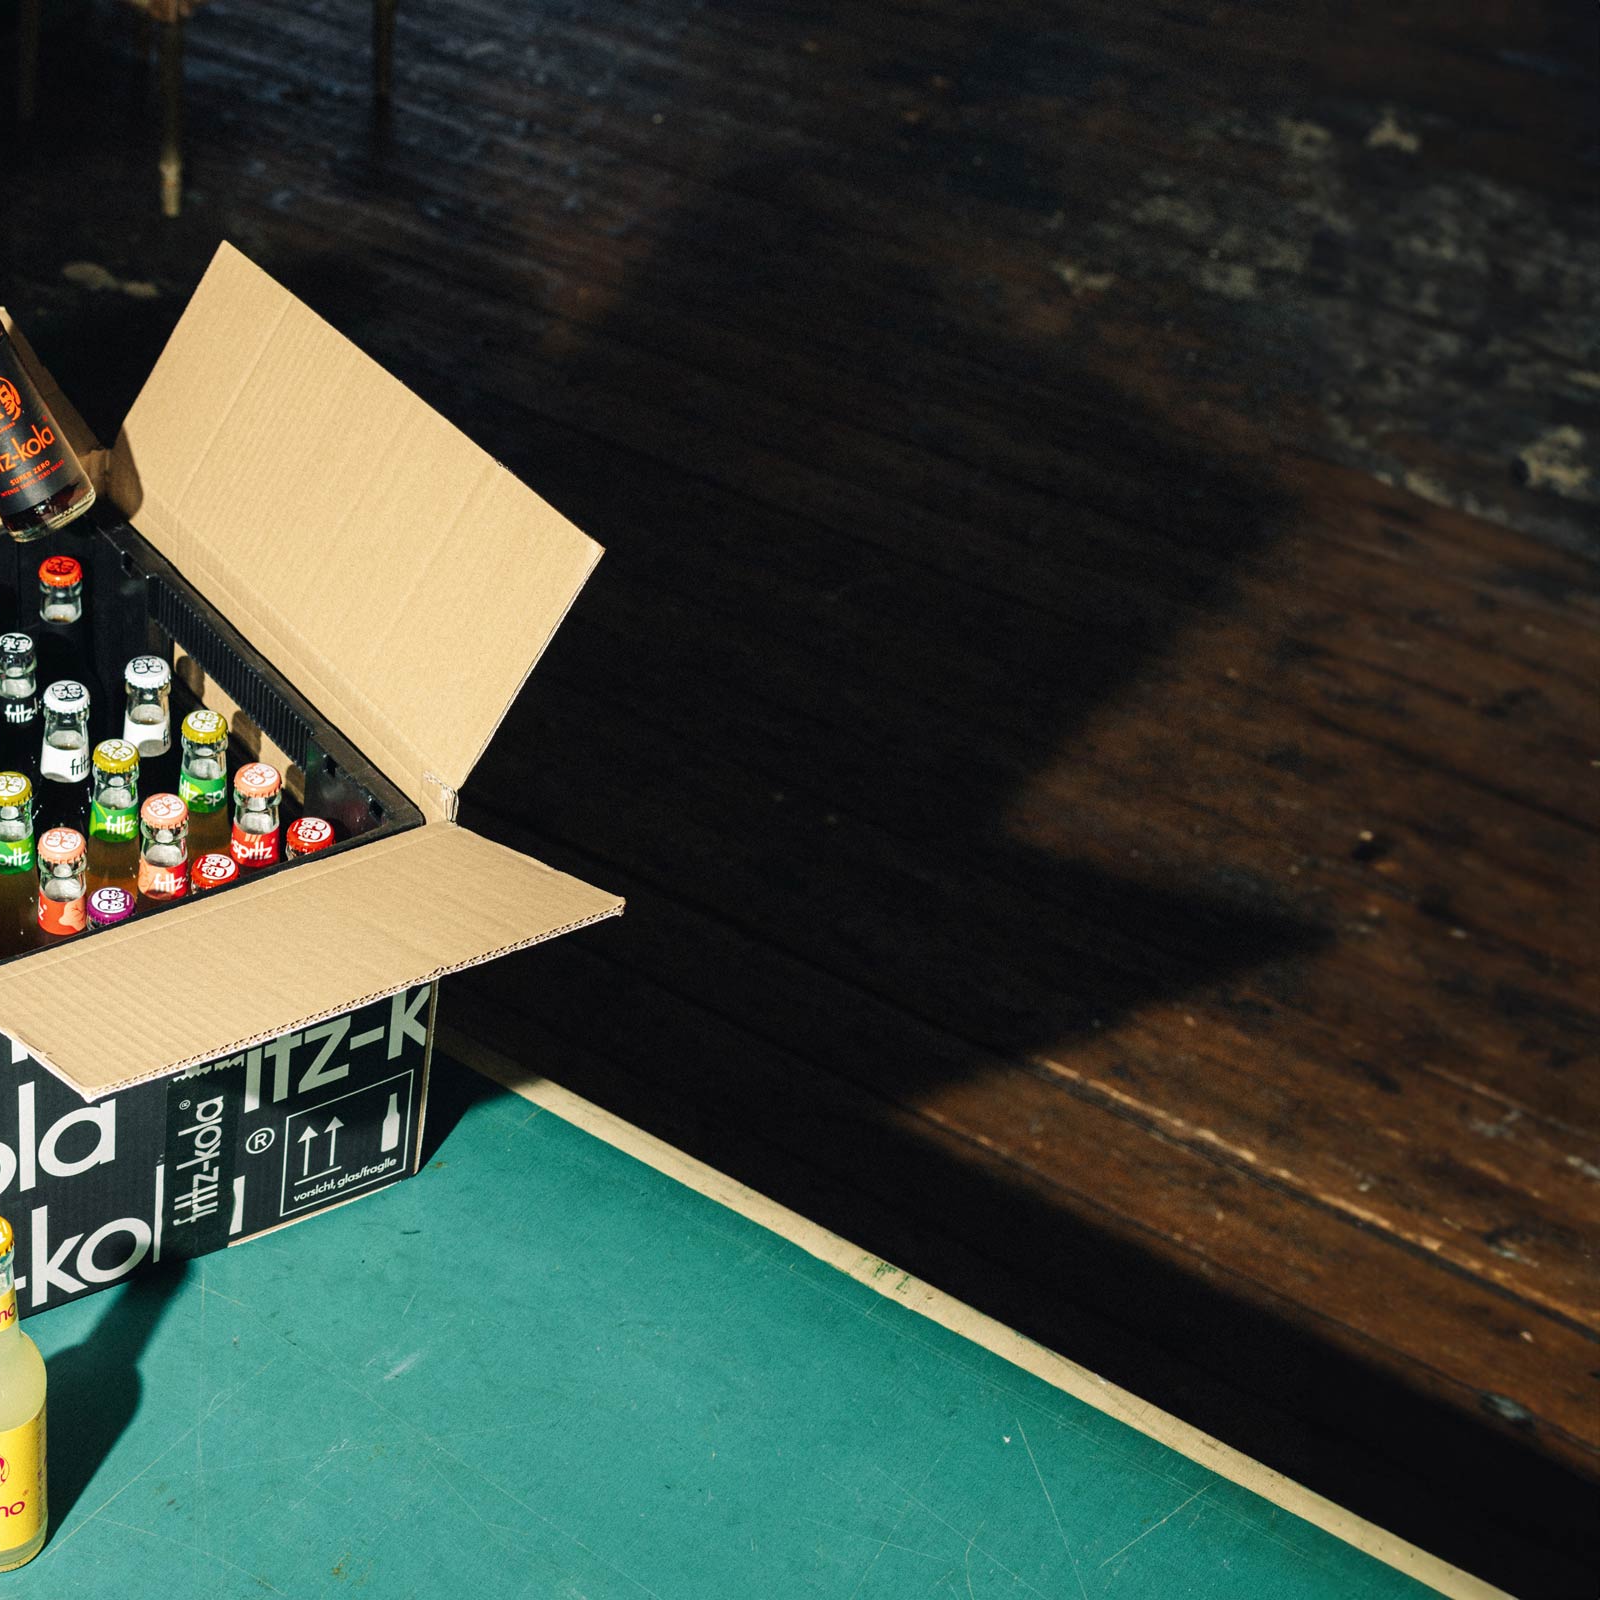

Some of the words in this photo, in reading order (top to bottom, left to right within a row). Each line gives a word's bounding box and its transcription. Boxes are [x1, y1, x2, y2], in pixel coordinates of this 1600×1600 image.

[33, 459, 51, 475] ZERO
[293, 1179, 336, 1202] vorsicht,
[337, 1157, 397, 1189] glas/fragile
